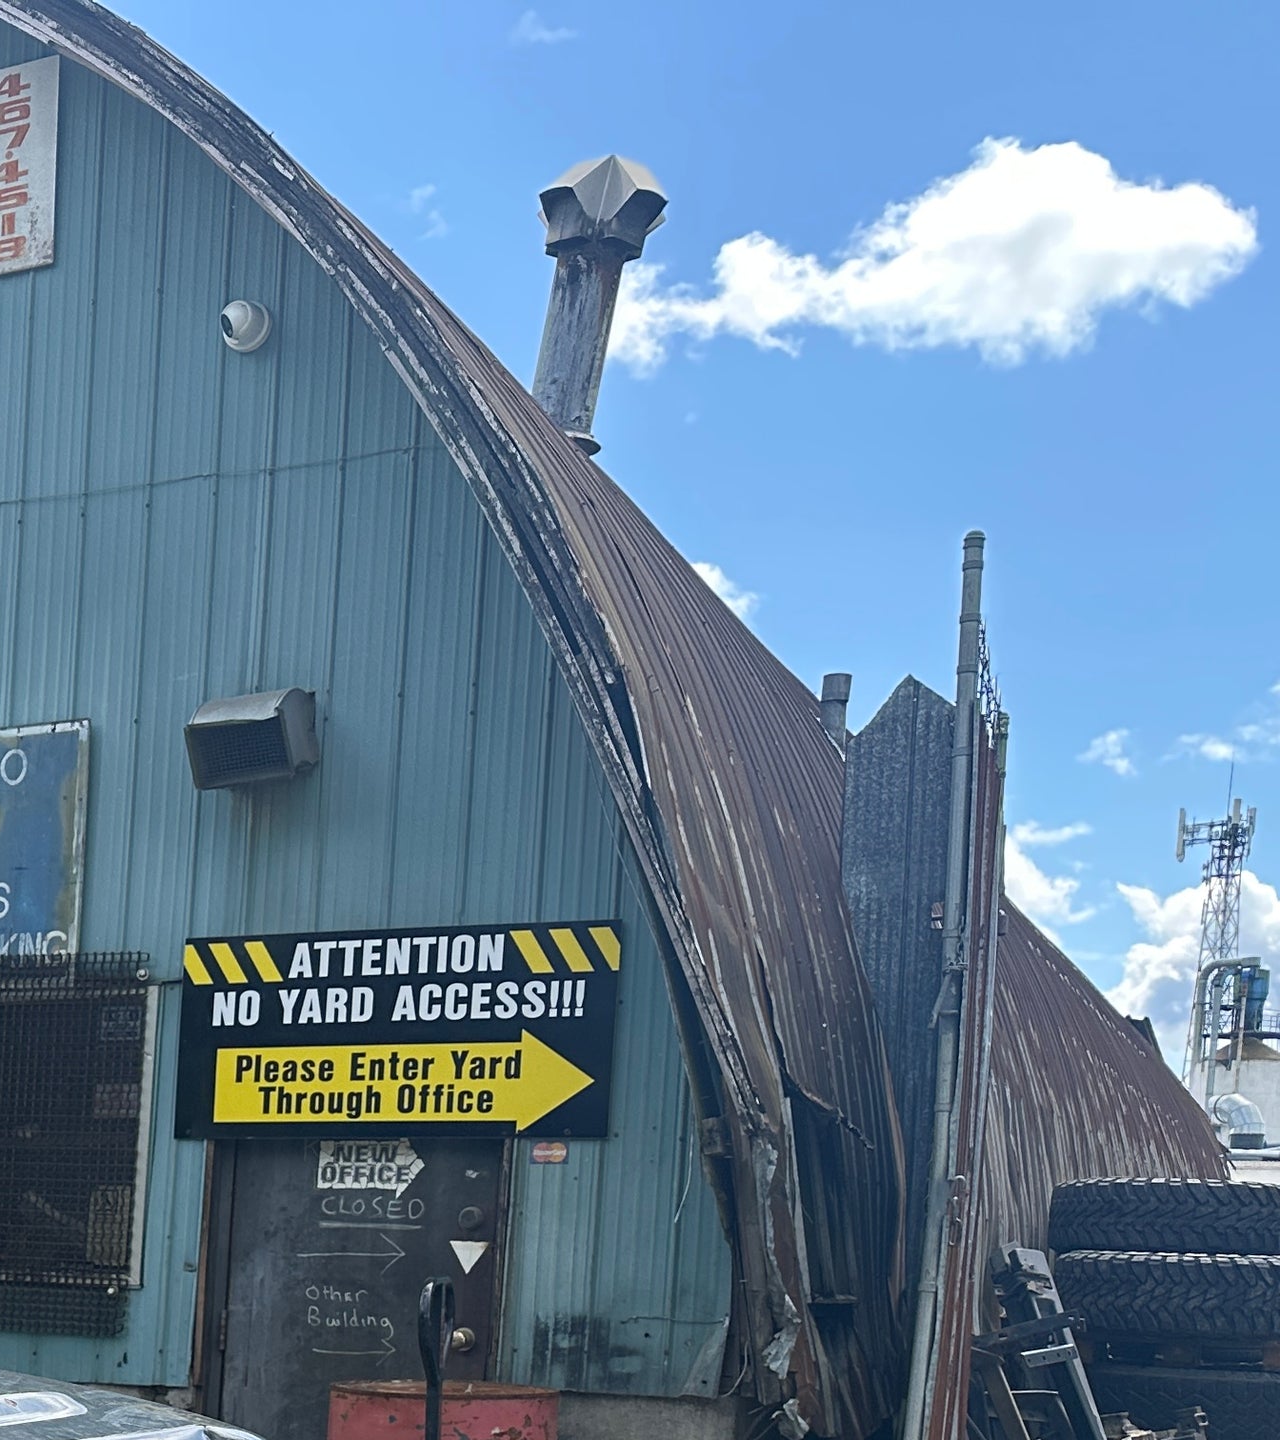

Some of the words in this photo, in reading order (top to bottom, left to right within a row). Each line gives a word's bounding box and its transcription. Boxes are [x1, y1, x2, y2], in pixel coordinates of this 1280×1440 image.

[288, 933, 505, 979] ATTENTION
[212, 991, 260, 1027] NO
[278, 986, 374, 1025] YARD
[391, 980, 586, 1021] ACCESS!!!
[234, 1054, 334, 1083] Please
[349, 1052, 434, 1081] Enter
[451, 1050, 522, 1080] Yard
[258, 1085, 381, 1119] Through
[397, 1084, 493, 1114] Office
[333, 1143, 398, 1163] NEW
[320, 1161, 411, 1184] OFFICE
[321, 1196, 425, 1220] CLOSED
[308, 1306, 394, 1338] Building
